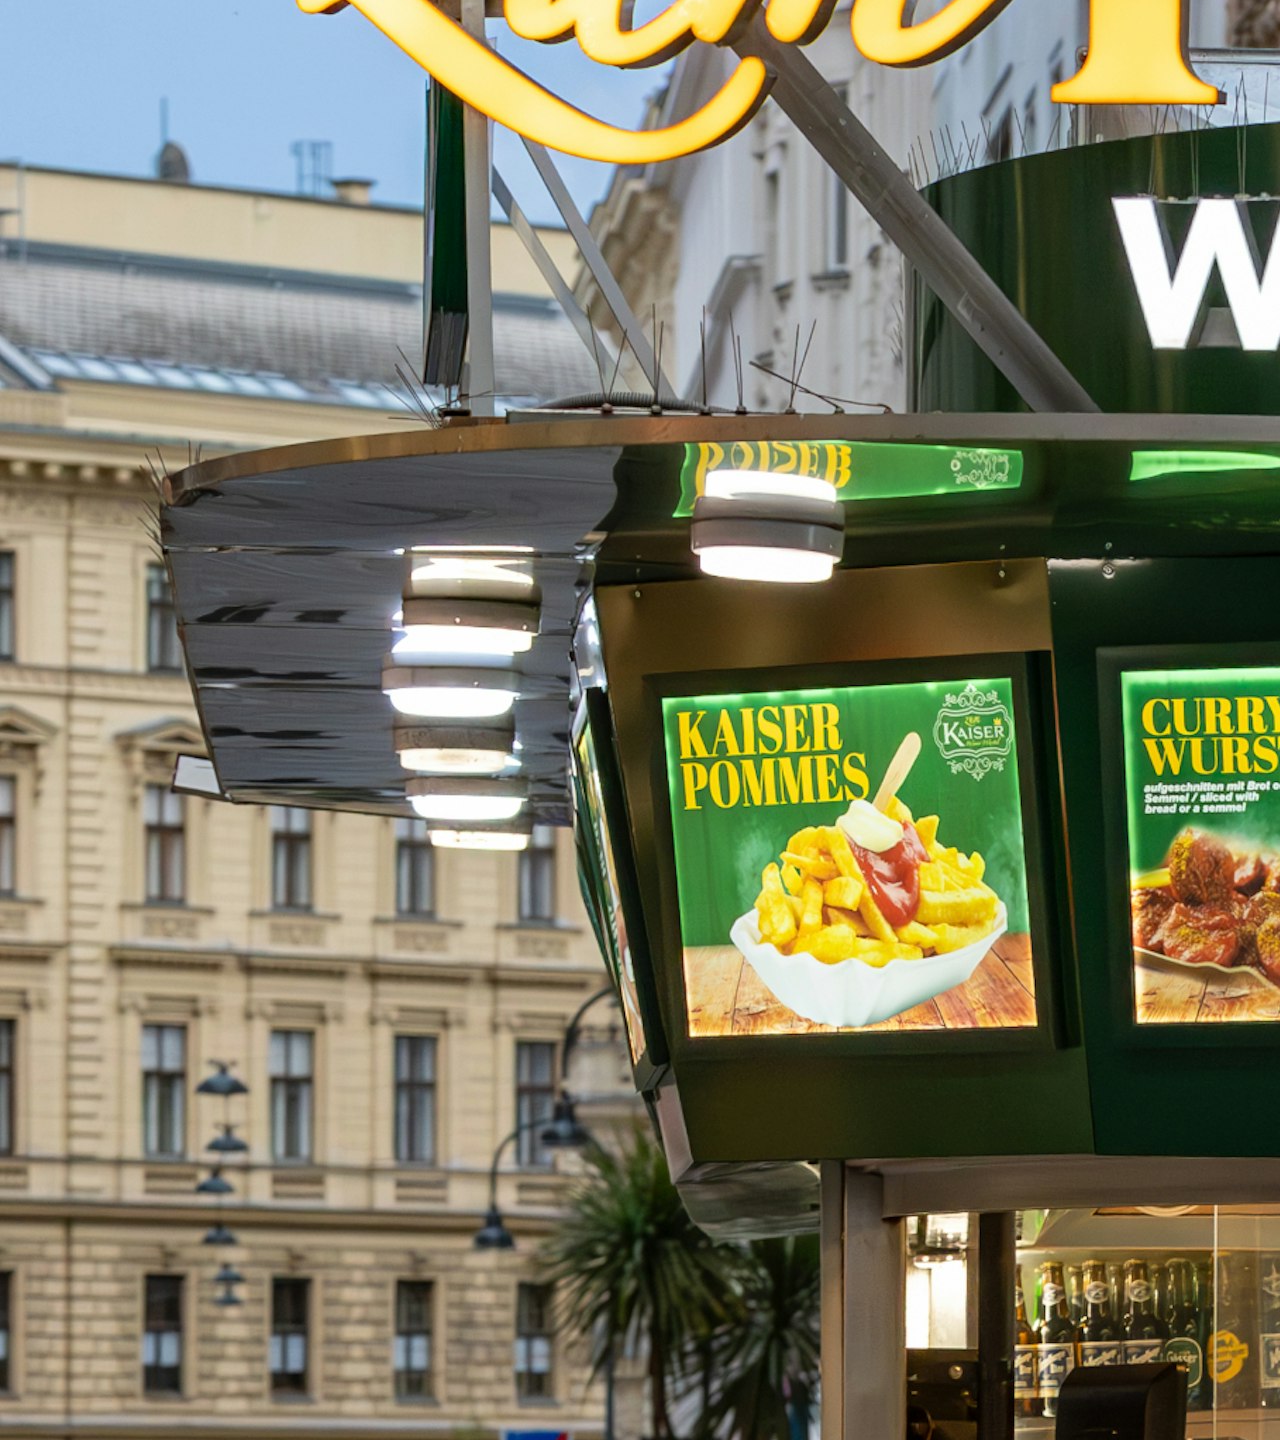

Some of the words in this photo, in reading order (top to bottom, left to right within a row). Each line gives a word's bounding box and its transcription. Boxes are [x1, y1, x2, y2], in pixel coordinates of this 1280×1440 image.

[677, 703, 844, 759] KAISER
[943, 721, 1005, 747] KAISER
[680, 752, 871, 810] POMMES
[1144, 782, 1224, 794] aufgeschnitten
[1226, 781, 1245, 791] mit
[1246, 780, 1270, 791] Brot
[1144, 793, 1189, 803] Semmel
[1200, 792, 1233, 802] sliced
[1235, 791, 1260, 801] with
[1144, 804, 1177, 814] bread
[1179, 805, 1191, 814] or
[1202, 802, 1246, 813] semmel
